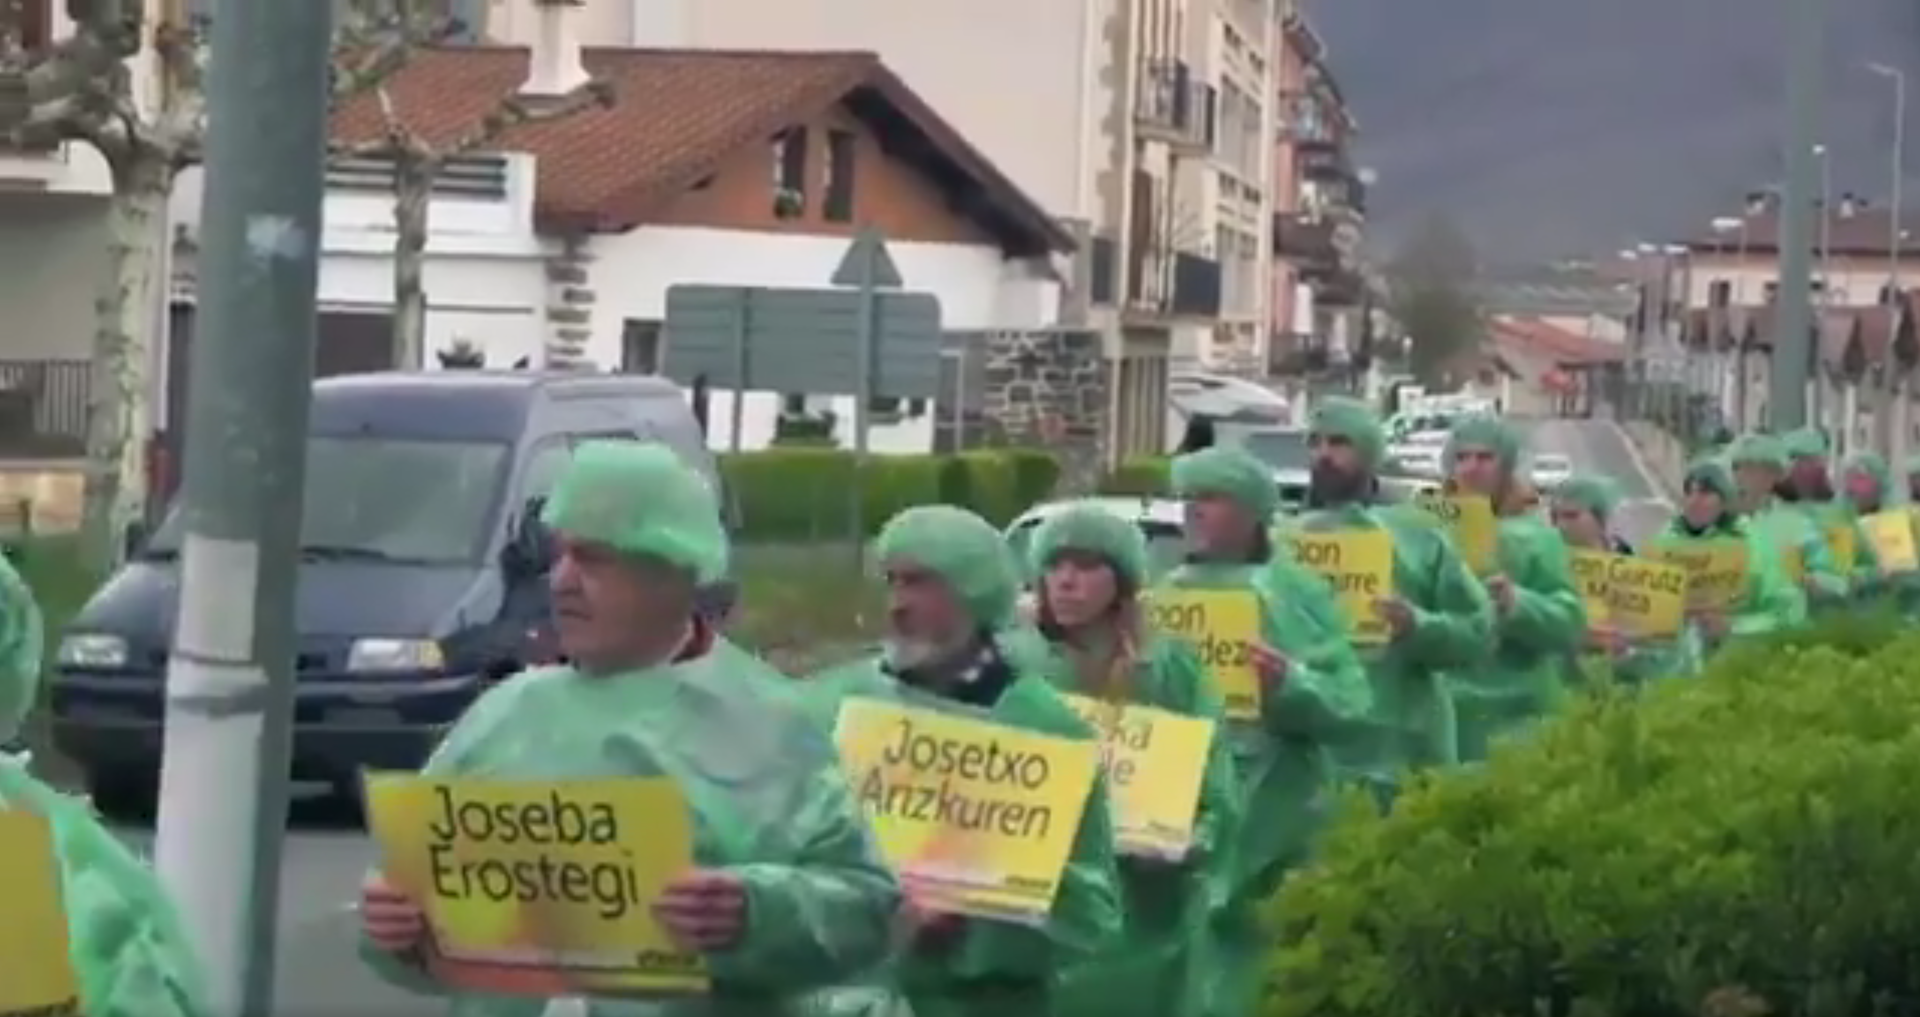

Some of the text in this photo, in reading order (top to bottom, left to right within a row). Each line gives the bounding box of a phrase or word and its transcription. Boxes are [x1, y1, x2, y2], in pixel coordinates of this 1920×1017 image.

[883, 720, 1050, 790] Josetxo
[428, 785, 617, 844] Joseba
[429, 844, 639, 920] Erostegi
